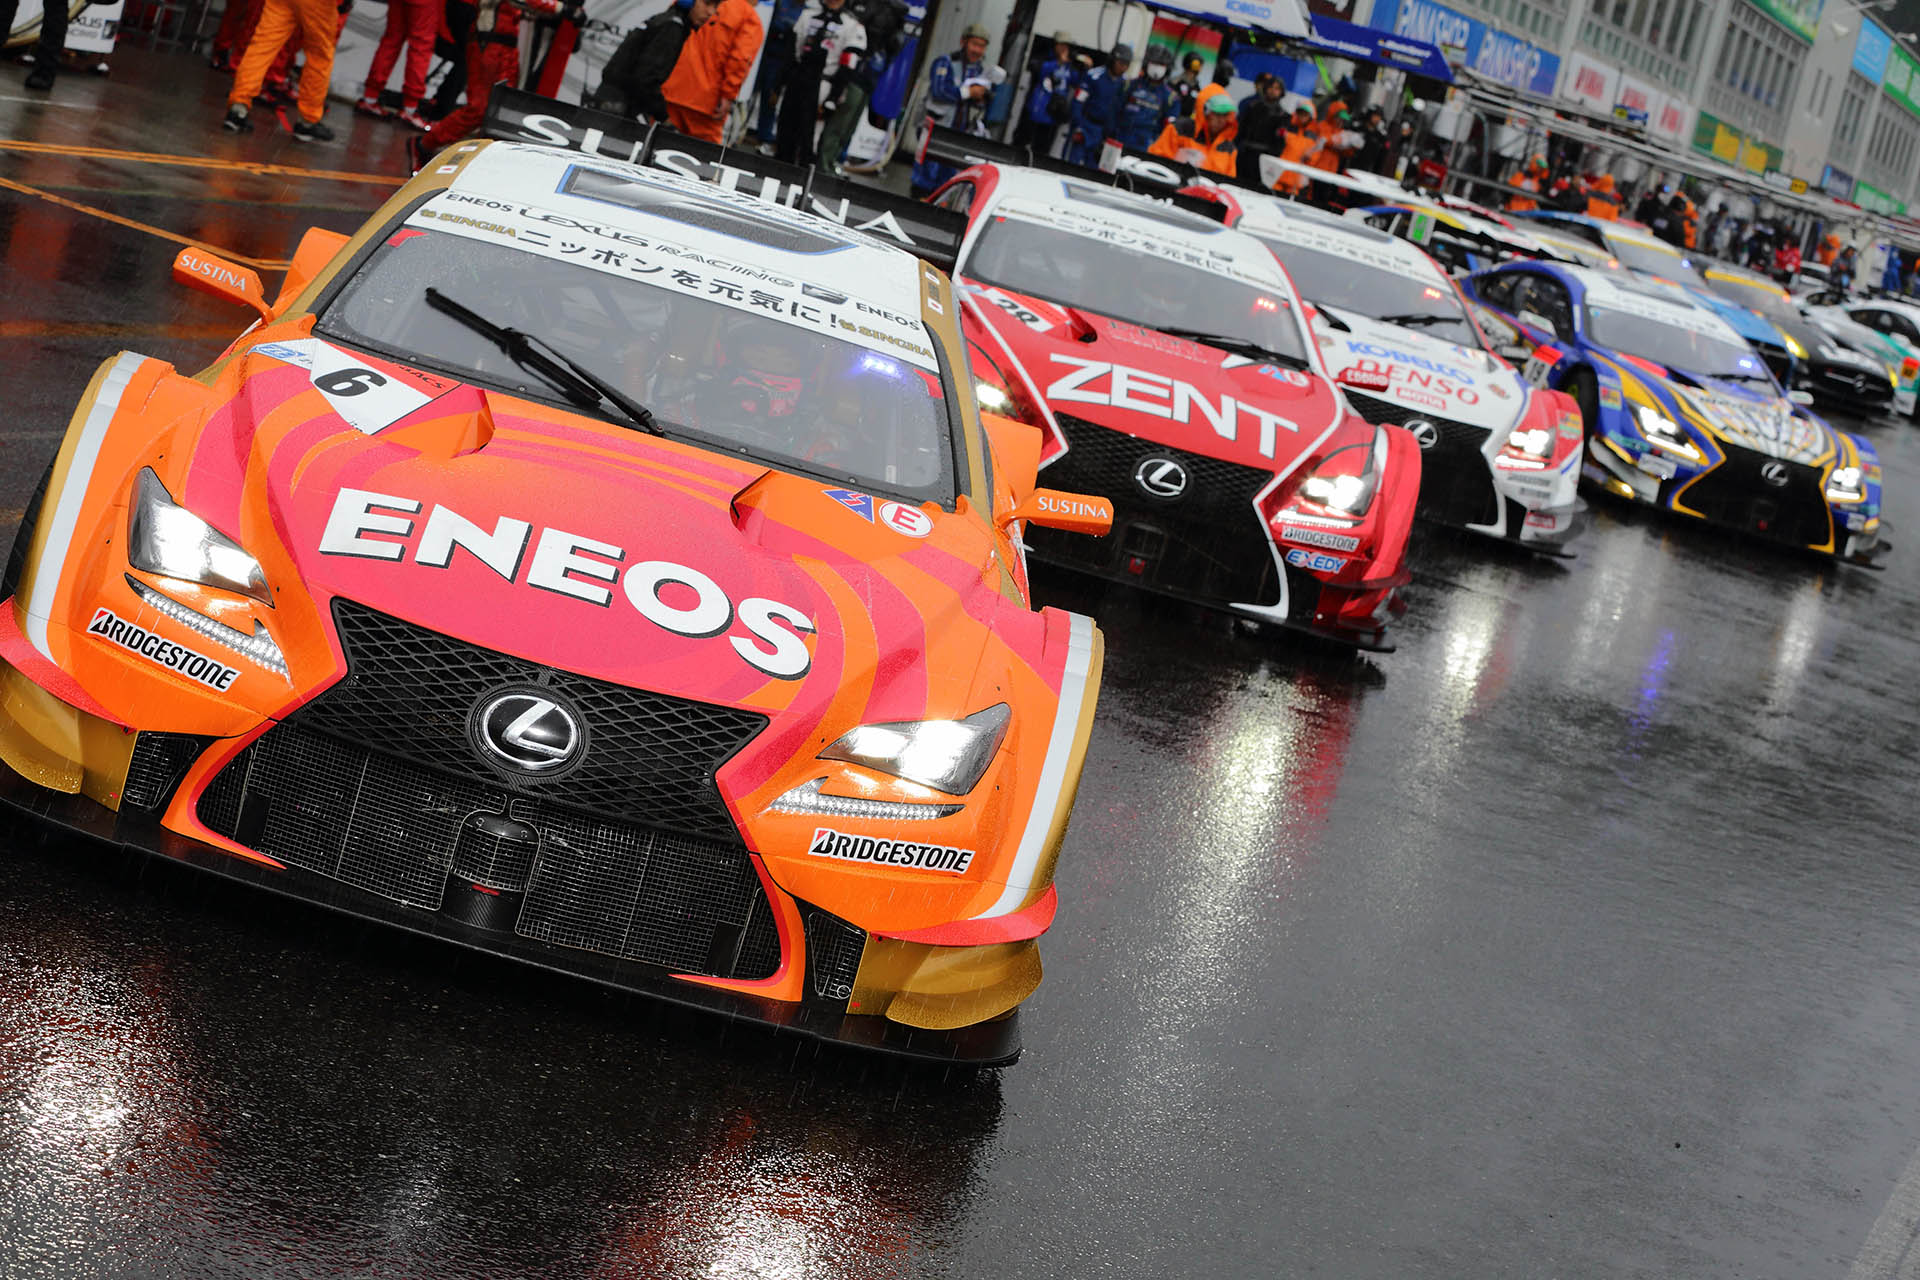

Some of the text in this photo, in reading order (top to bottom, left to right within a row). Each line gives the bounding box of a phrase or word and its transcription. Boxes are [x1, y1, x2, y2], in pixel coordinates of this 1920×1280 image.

[438, 212, 517, 238] SINGHA
[179, 254, 246, 292] SUSTINA
[446, 192, 920, 331] ENEOS LEXUS RACING ENEOS
[857, 325, 936, 361] SINGHA
[313, 367, 388, 398] 6
[1355, 358, 1480, 406] DENSO
[1046, 352, 1300, 460] ZENT
[1037, 495, 1109, 519] SUSTINA
[1284, 526, 1357, 551] BRIDGESTONE
[1286, 549, 1346, 573] EXEDY
[318, 486, 818, 681] ENEOS
[89, 609, 237, 690] BRIDGESTONE
[812, 829, 973, 873] BRIDGESTONE
